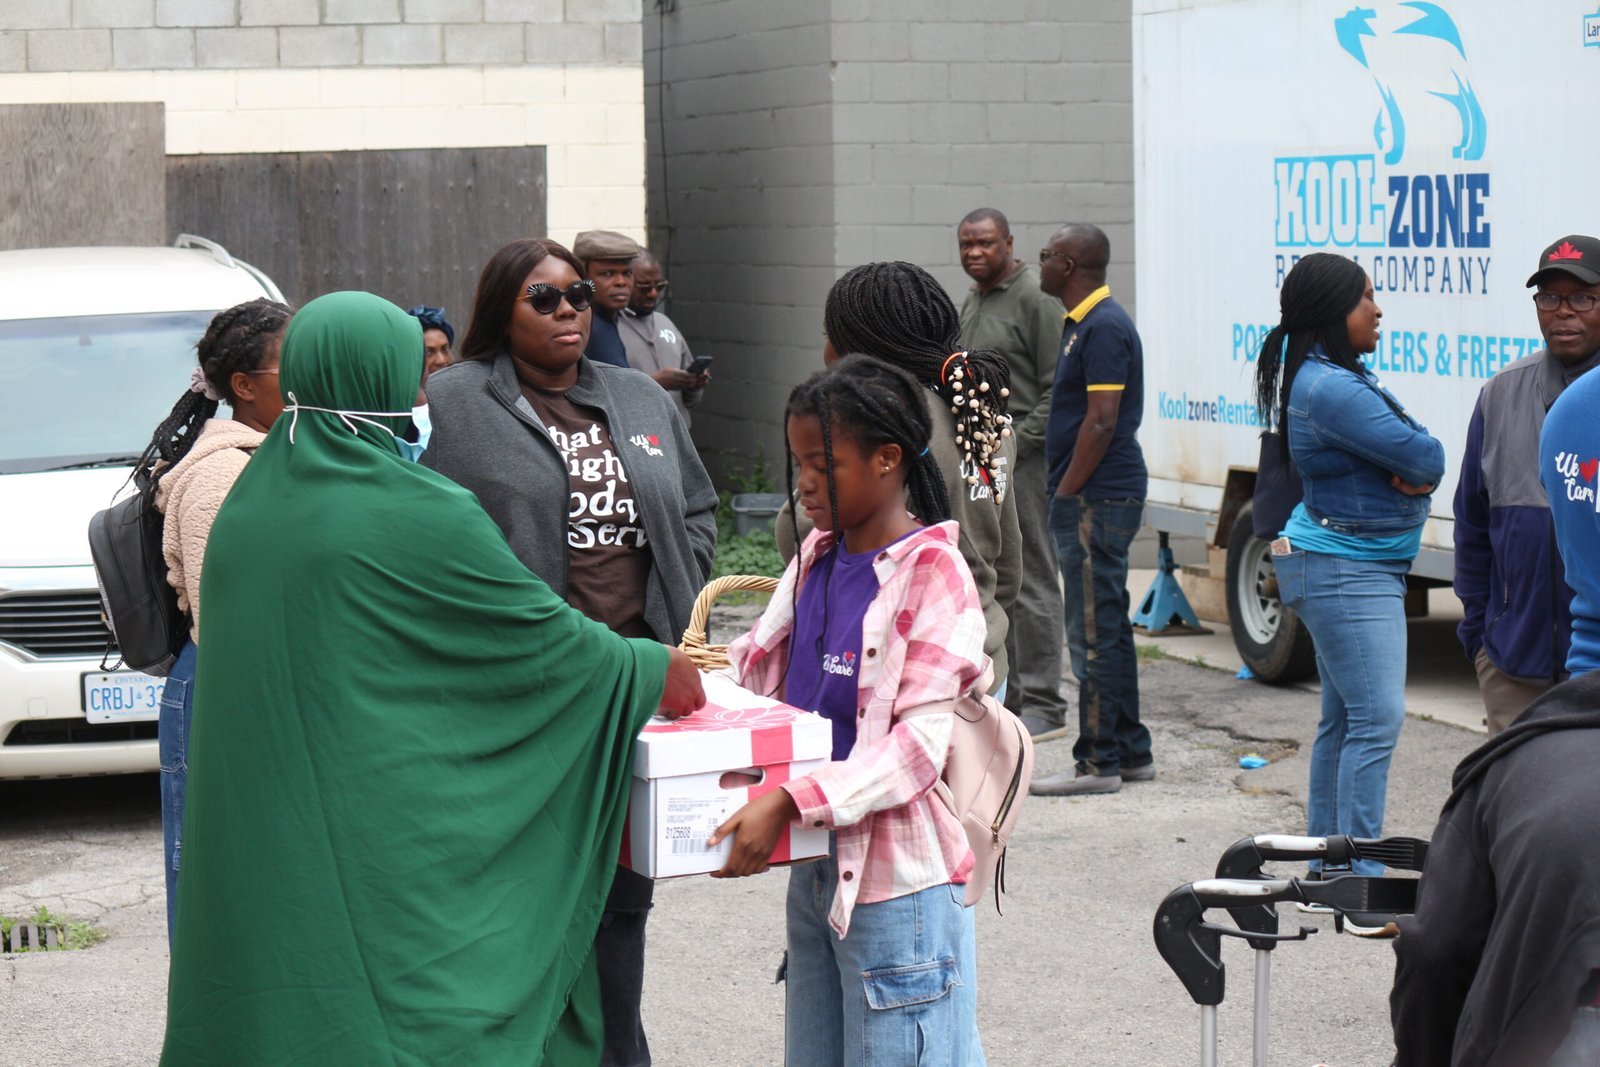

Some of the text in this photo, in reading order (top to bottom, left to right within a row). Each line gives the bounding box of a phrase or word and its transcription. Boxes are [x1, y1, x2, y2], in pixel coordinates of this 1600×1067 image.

[1274, 154, 1491, 248] KOOL ZONE
[1374, 255, 1491, 294] COMPANY
[1435, 333, 1452, 376] &
[90, 686, 134, 710] CRBJ
